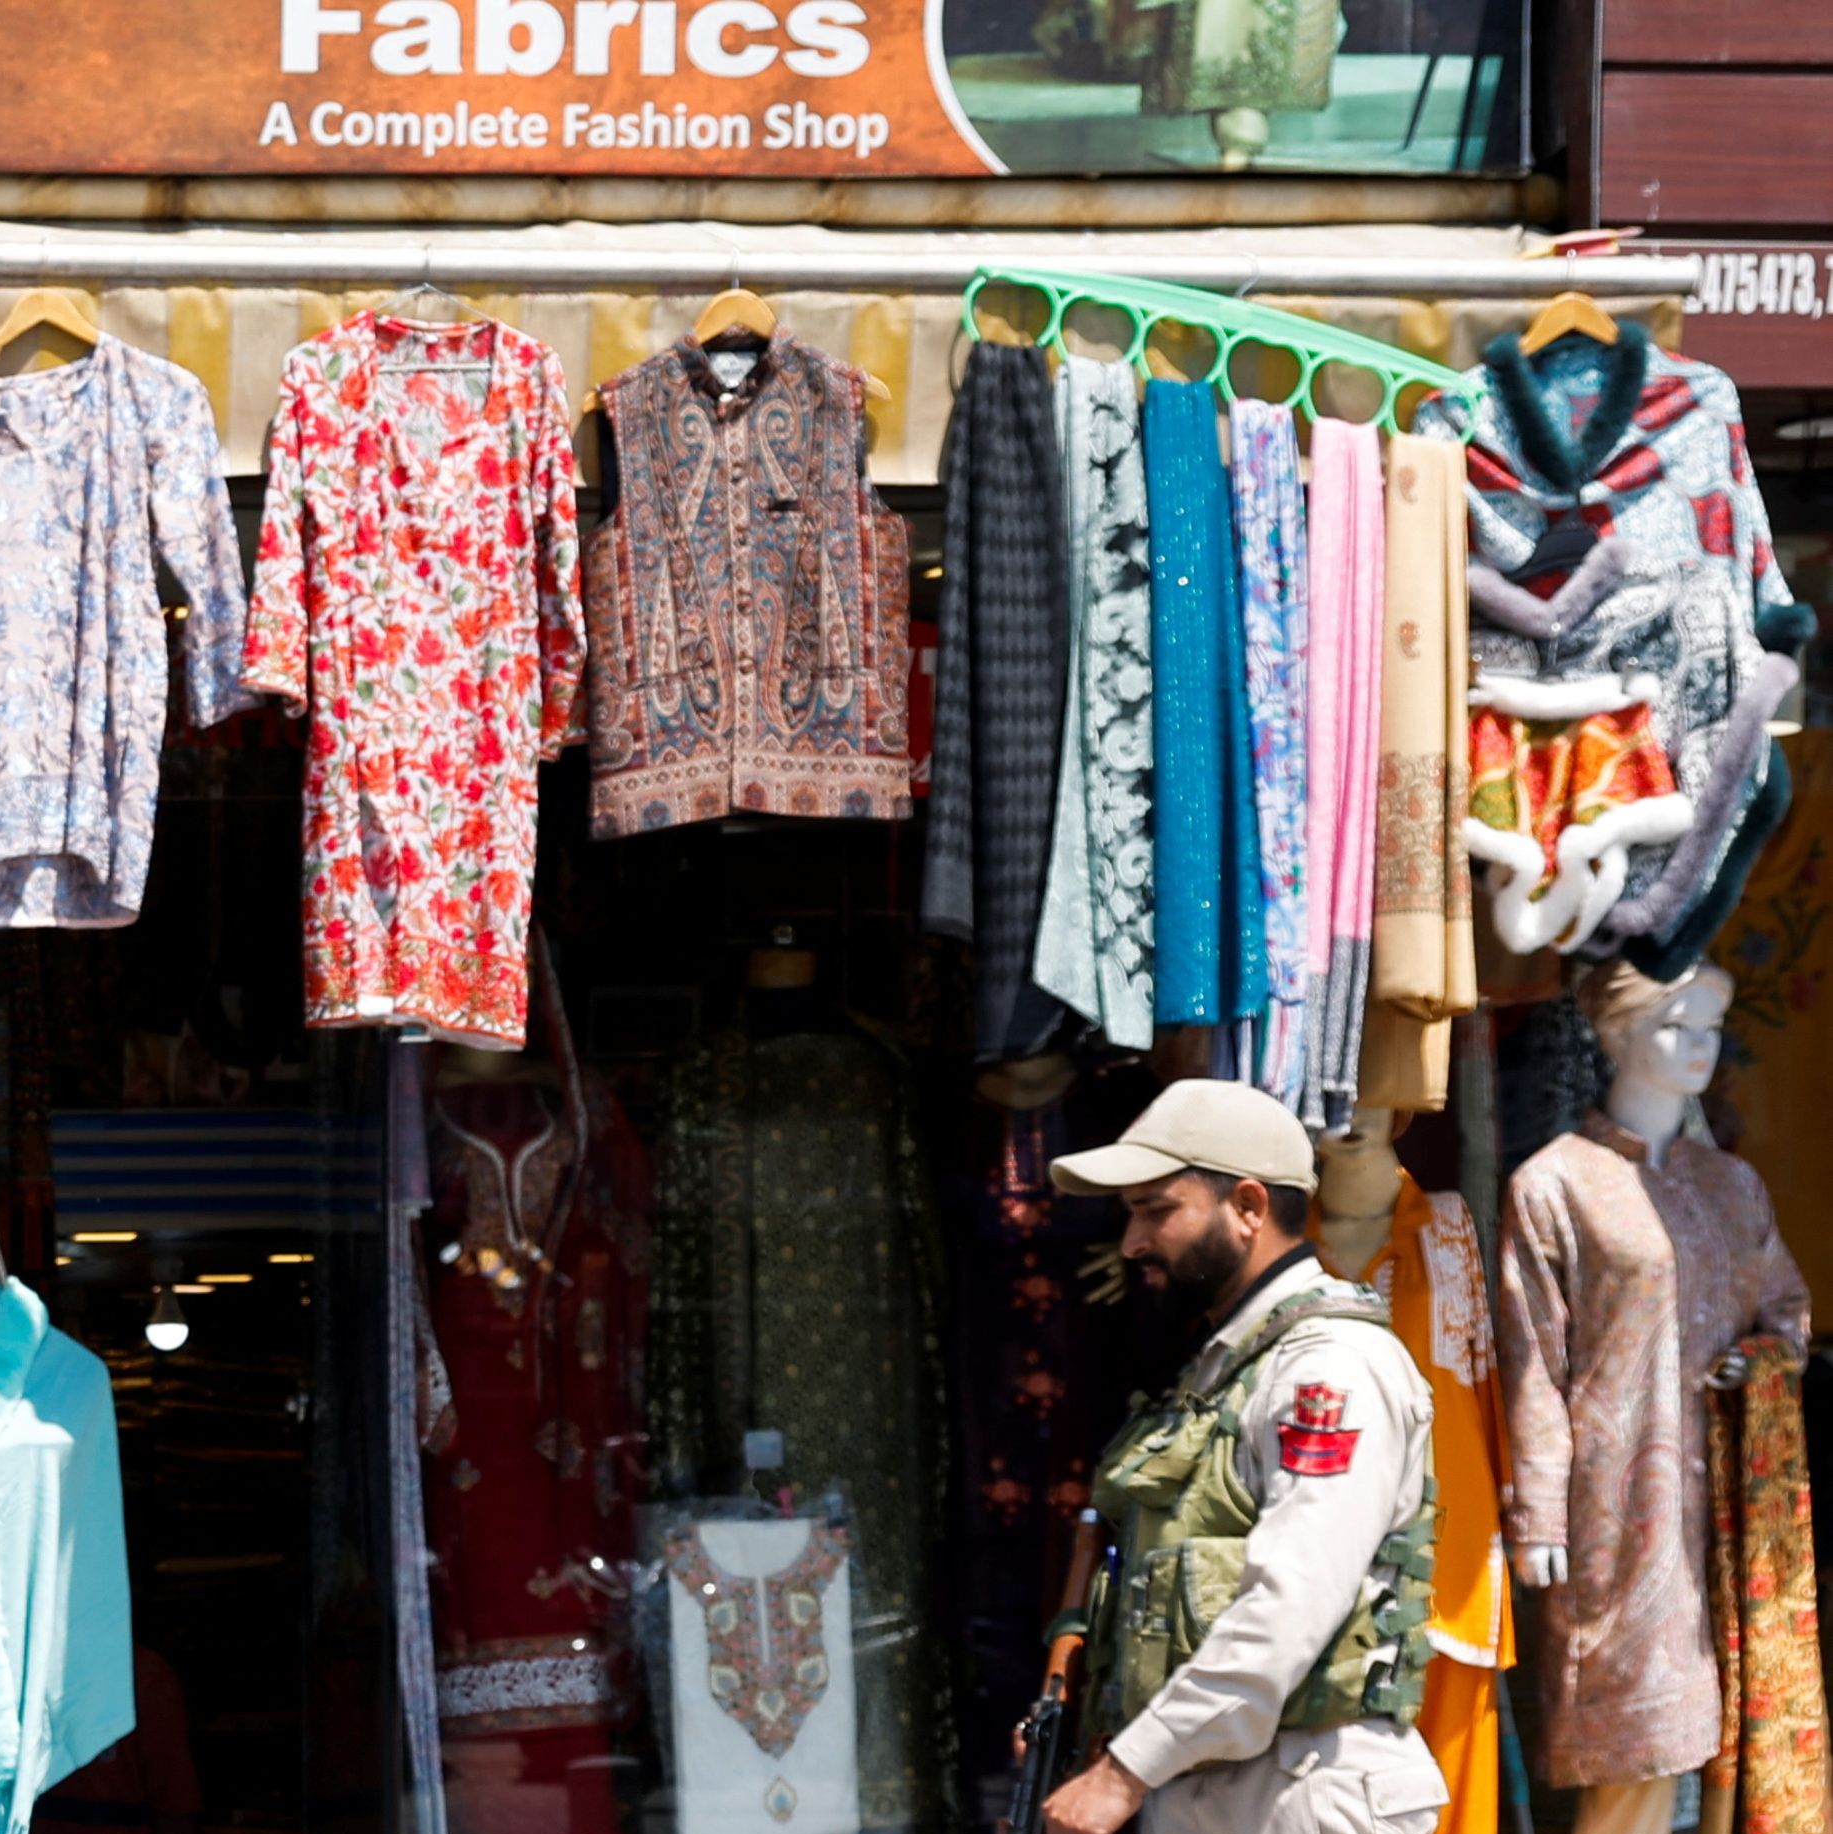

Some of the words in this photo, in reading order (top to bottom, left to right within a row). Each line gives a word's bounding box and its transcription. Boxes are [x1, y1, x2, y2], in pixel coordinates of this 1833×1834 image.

[279, 0, 871, 77] Fabrics
[259, 102, 299, 146] A
[309, 101, 549, 157] Complete
[562, 101, 751, 149] Fashion
[763, 101, 889, 157] Shop
